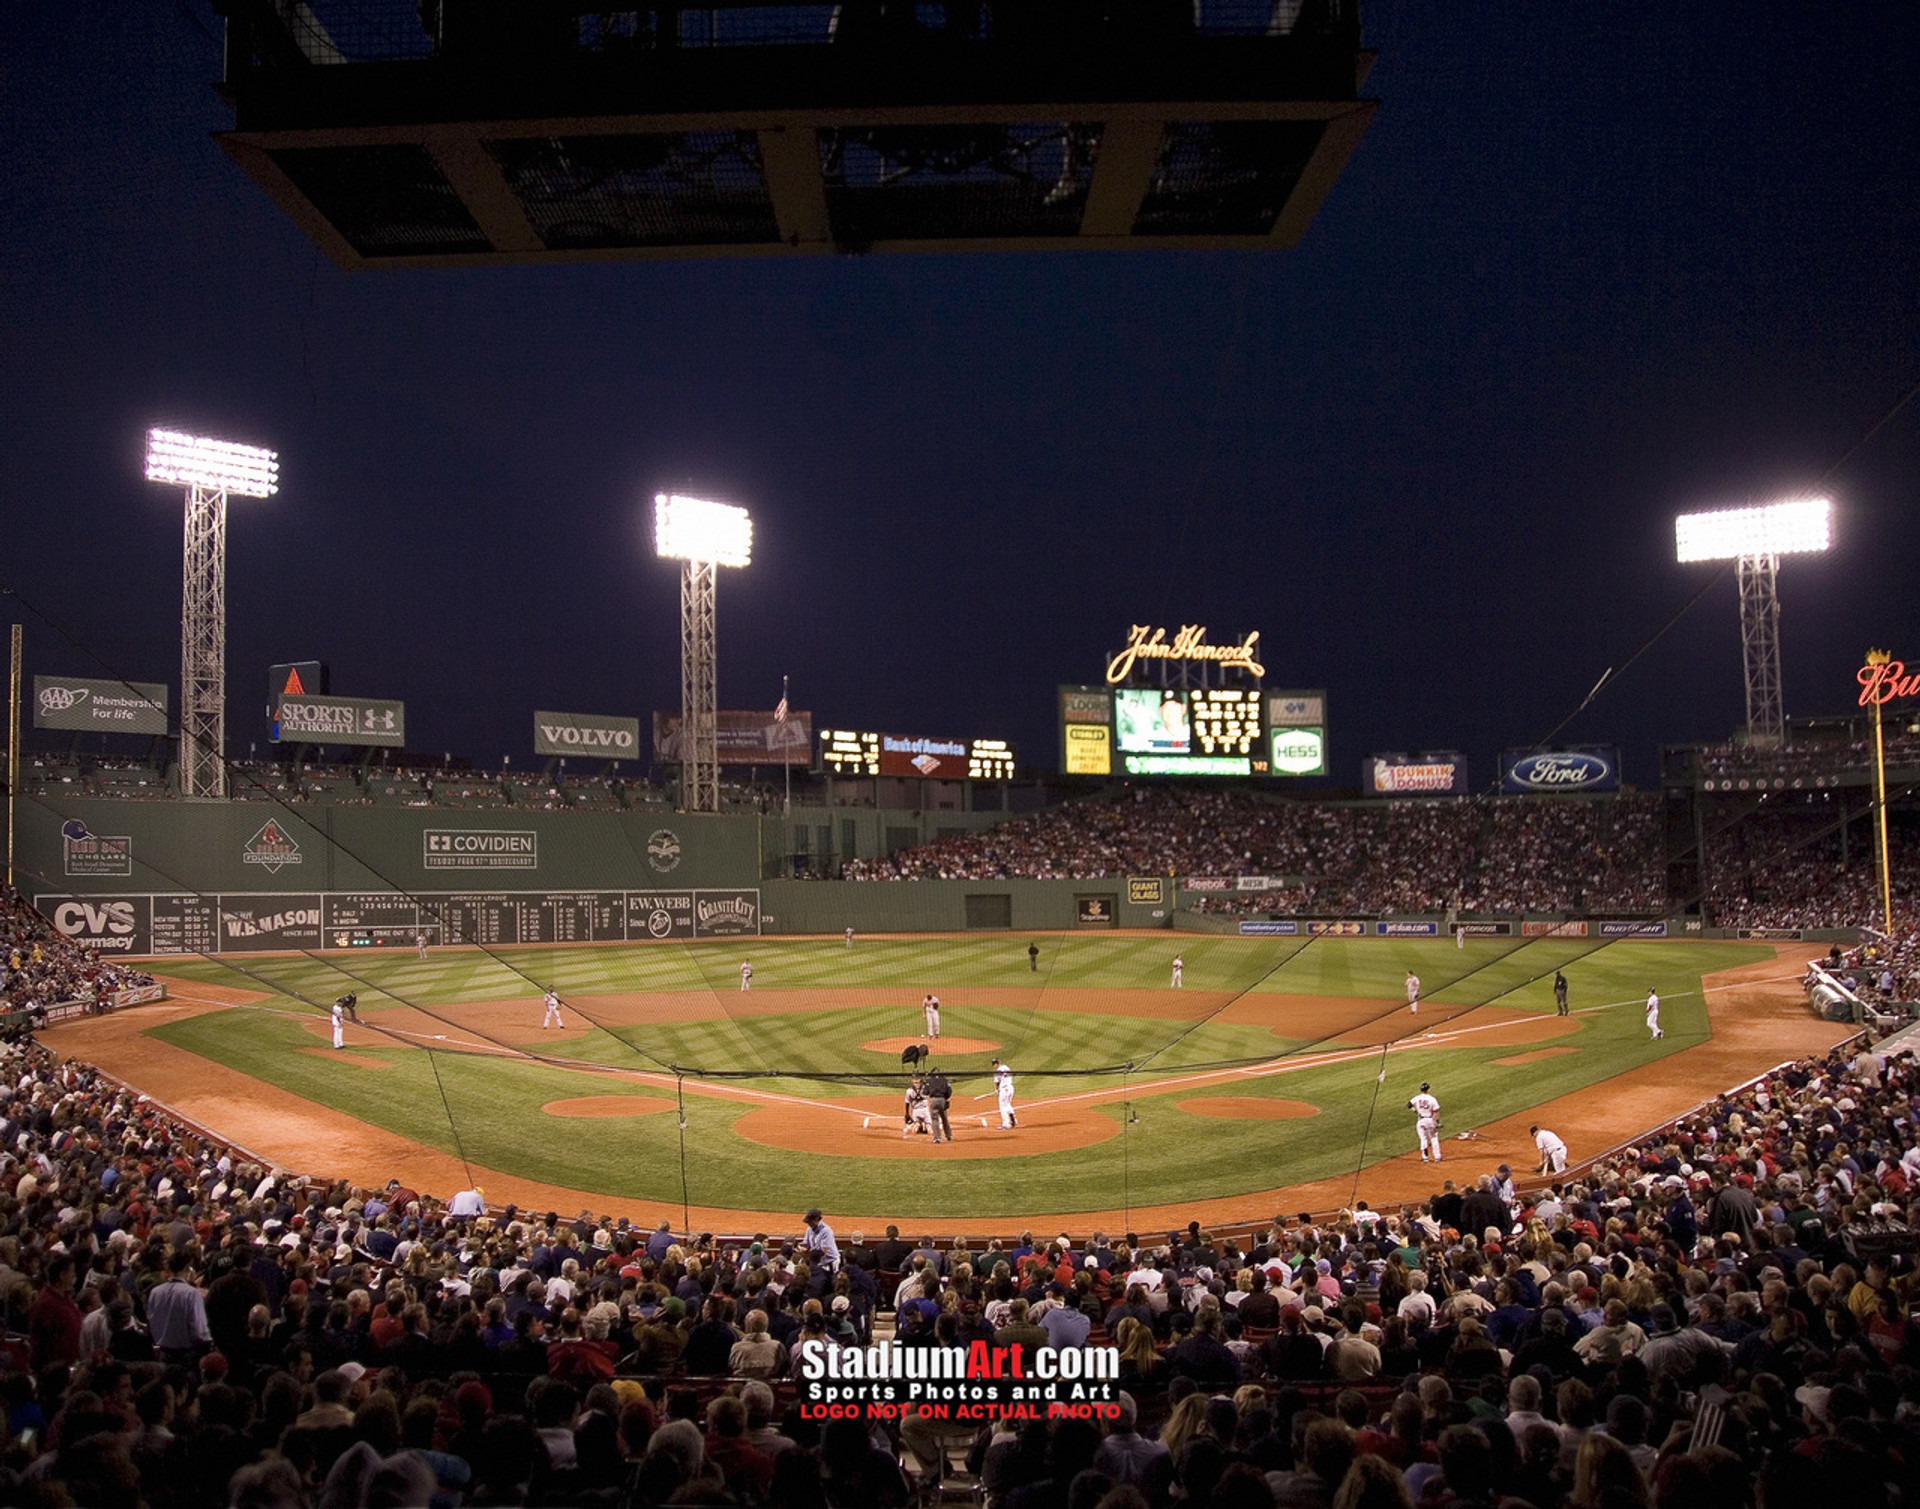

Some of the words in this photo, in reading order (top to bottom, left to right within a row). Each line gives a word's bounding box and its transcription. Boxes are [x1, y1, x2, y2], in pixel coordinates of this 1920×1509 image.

[1107, 624, 1171, 683] John
[1169, 624, 1265, 677] Hancock
[93, 696, 163, 711] Membership
[92, 708, 111, 719] For
[113, 710, 134, 720] life
[282, 703, 354, 723] SPORTS
[283, 720, 354, 734] AUTHORITY
[540, 725, 633, 748] VOLVO
[884, 736, 910, 752] Bank
[910, 739, 923, 753] of
[923, 738, 966, 756] America
[1277, 745, 1318, 758] HESS
[1530, 759, 1588, 784] Ford
[1396, 776, 1454, 790] DONUTS
[454, 836, 532, 851] COVIDIEN
[1132, 882, 1158, 891] GIANT
[1187, 879, 1227, 890] Reebok
[1131, 890, 1159, 900] GLASS
[653, 897, 691, 910] WEBB
[698, 899, 735, 921] GRANITE
[735, 896, 756, 920] CITY
[54, 902, 135, 934] CVS
[258, 909, 320, 933] MASON
